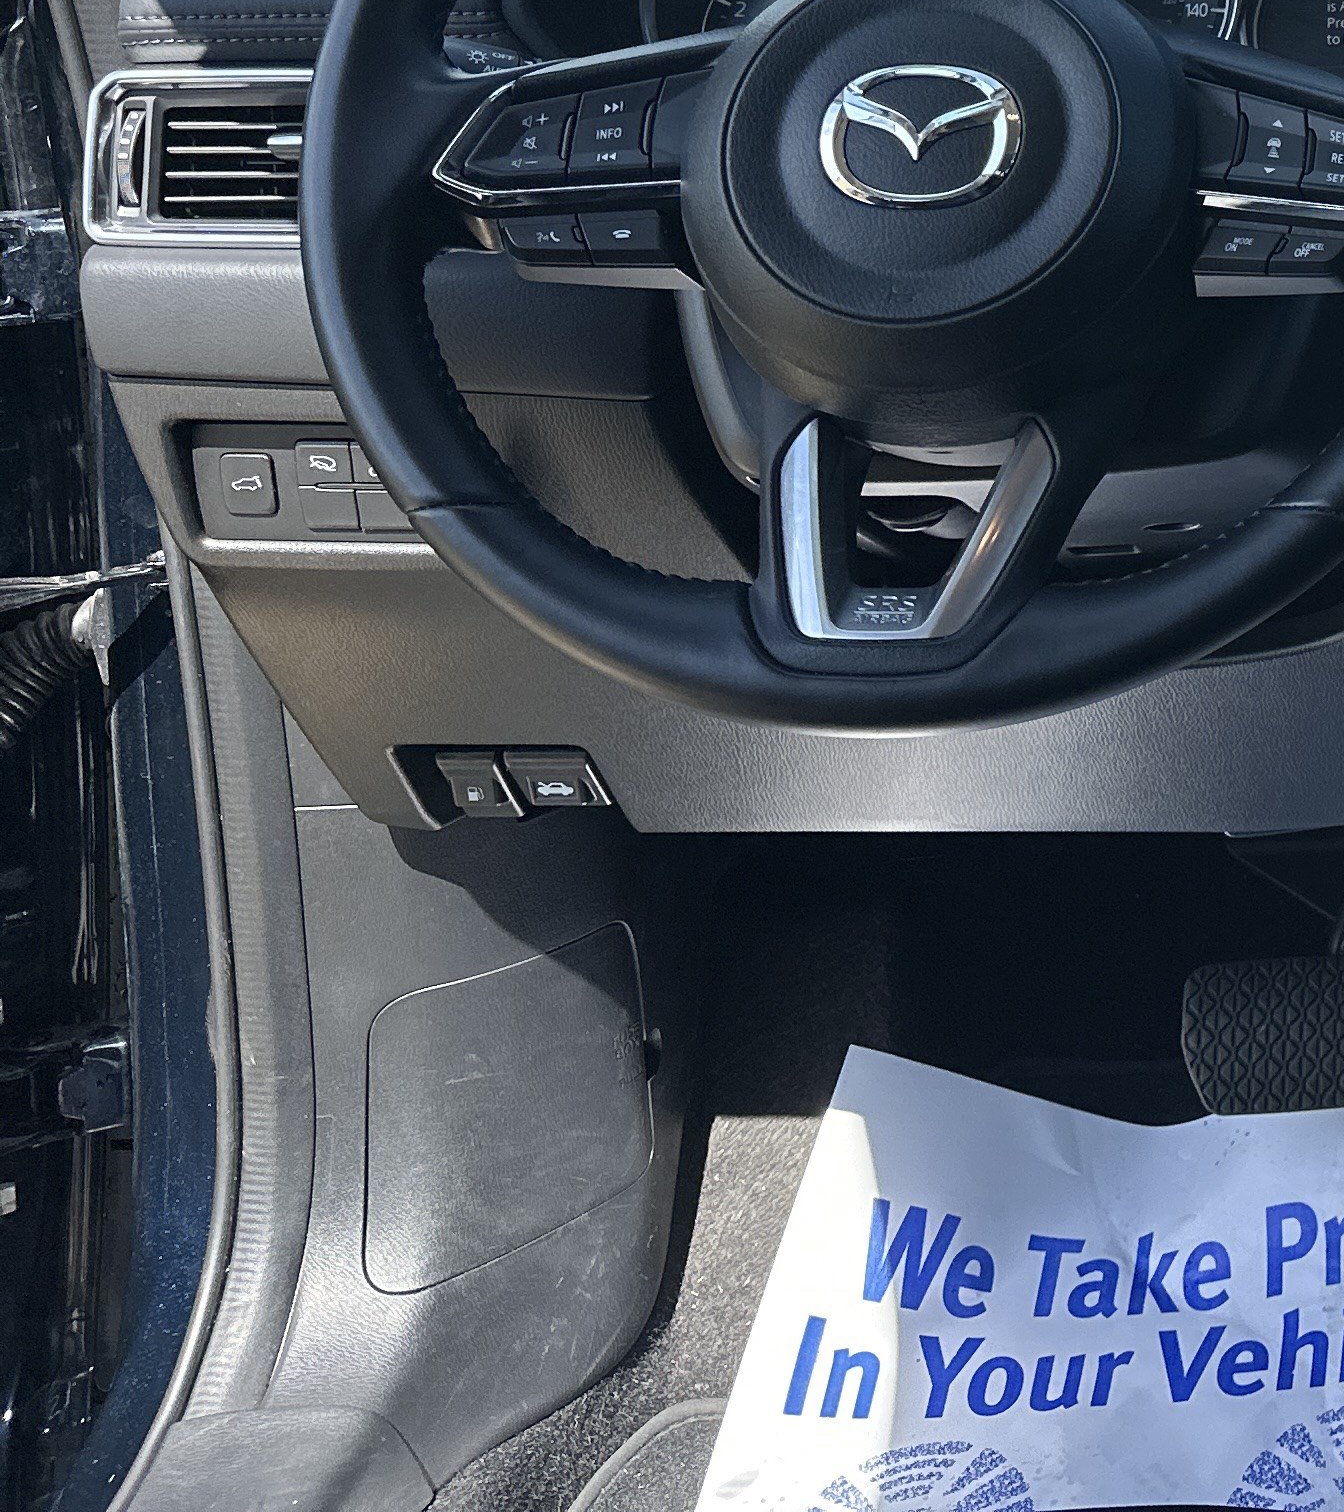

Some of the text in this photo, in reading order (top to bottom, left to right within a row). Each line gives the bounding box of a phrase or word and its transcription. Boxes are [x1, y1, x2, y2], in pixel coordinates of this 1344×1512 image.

[733, 1, 747, 19] 2
[1185, 3, 1209, 18] 140
[1327, 1, 1337, 13] is
[1326, 34, 1341, 45] to
[596, 128, 623, 140] INFO
[1225, 242, 1238, 252] ON
[1234, 237, 1254, 246] MODE
[1302, 242, 1325, 252] CANCEL
[1294, 248, 1310, 258] OFF
[857, 595, 917, 612] SRS
[863, 1197, 997, 1321] We
[1026, 1231, 1232, 1320] Take
[783, 1315, 881, 1420] In
[919, 1333, 1136, 1420] Your
